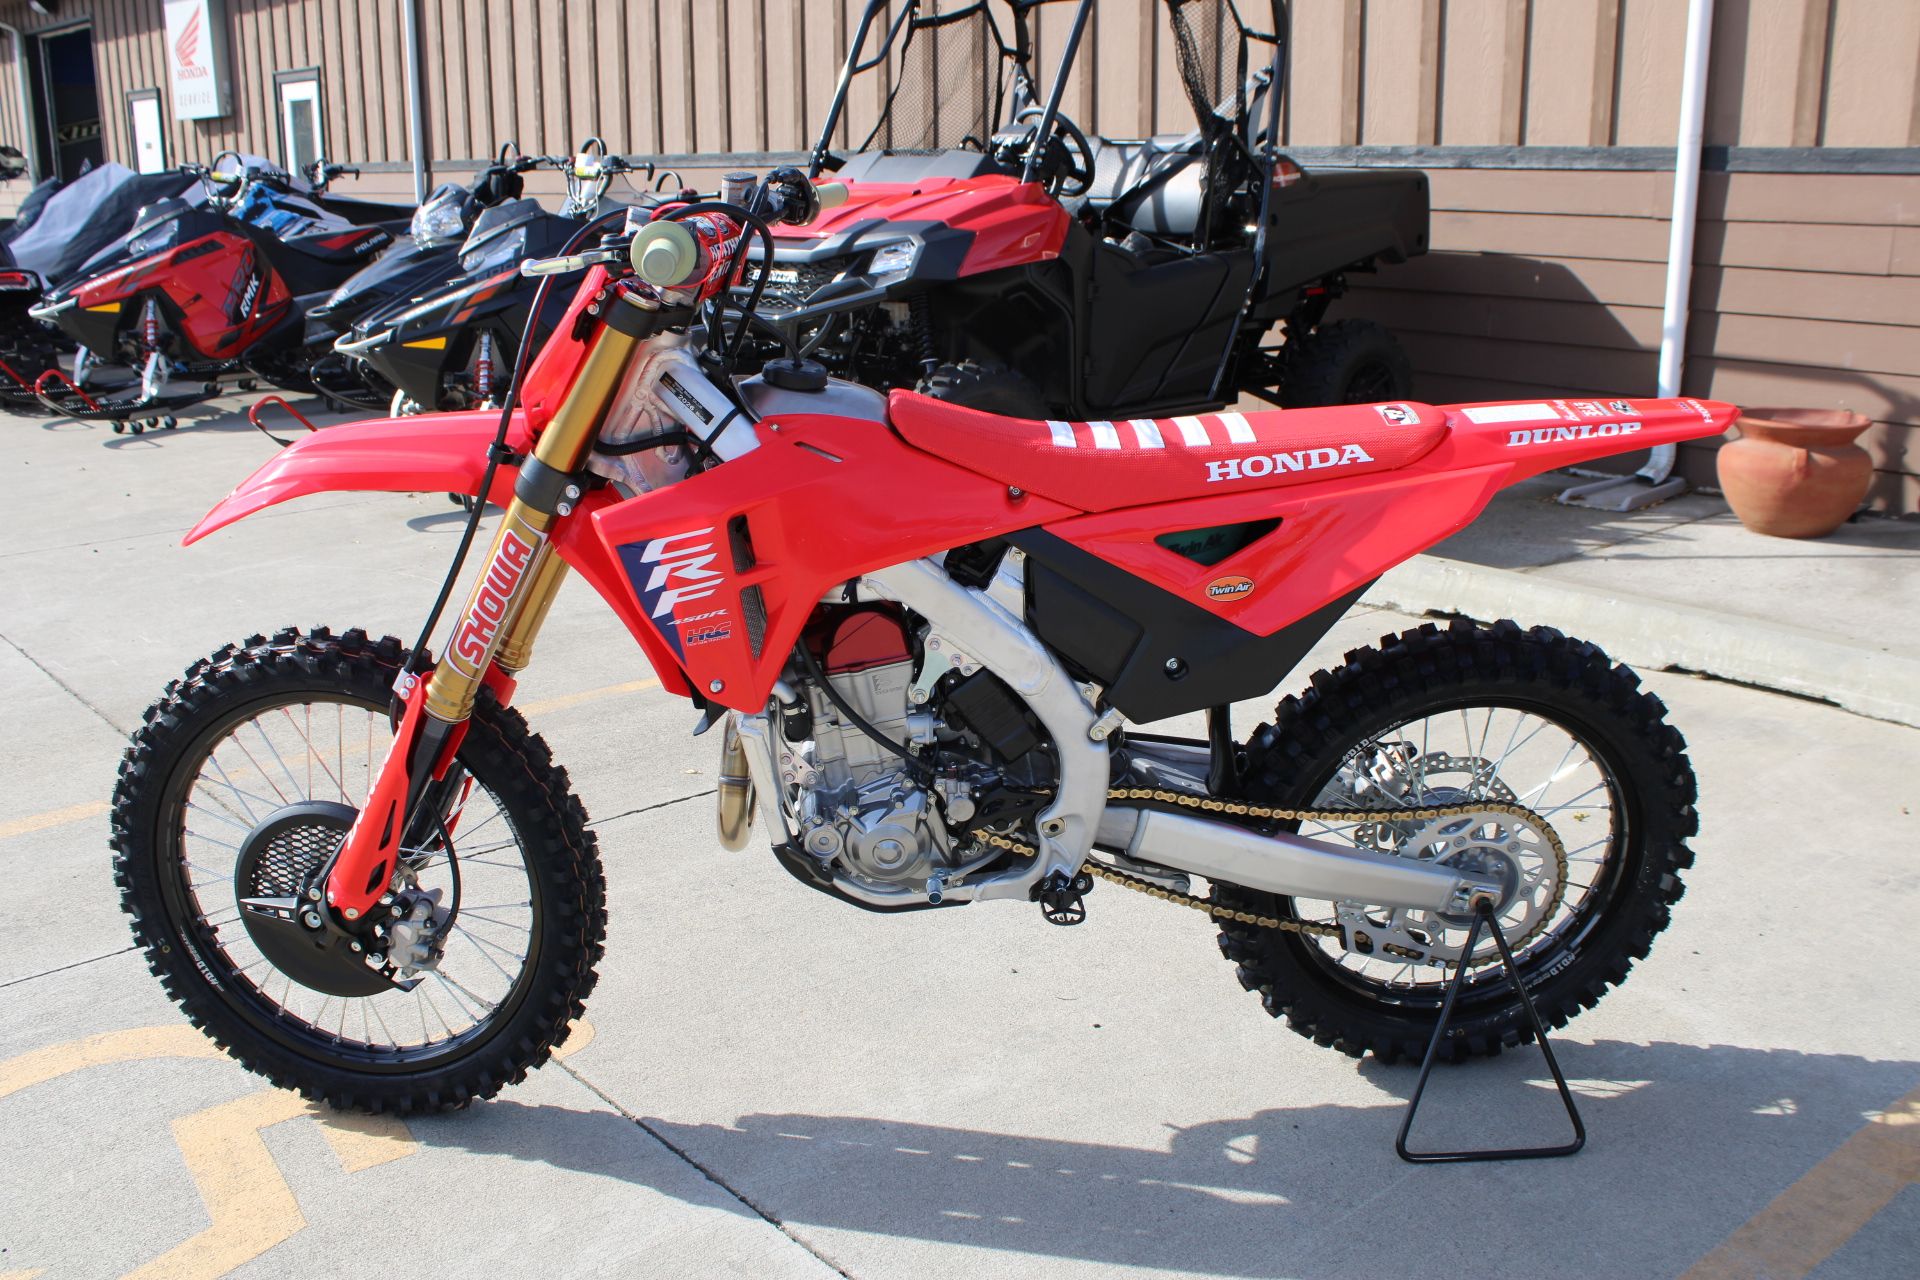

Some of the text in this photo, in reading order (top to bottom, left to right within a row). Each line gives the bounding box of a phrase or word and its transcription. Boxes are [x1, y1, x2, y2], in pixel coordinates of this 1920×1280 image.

[177, 66, 208, 80] HONDA
[354, 232, 388, 254] POLARIS
[239, 273, 260, 319] RMK
[678, 394, 695, 411] 2026
[1507, 422, 1641, 446] DUNLOP
[1206, 444, 1374, 482] HONDA
[640, 526, 726, 620] CRF
[456, 529, 535, 669] SHOWA
[1209, 581, 1252, 597] Twin Air
[666, 608, 729, 625] 450R
[686, 620, 732, 643] HRC
